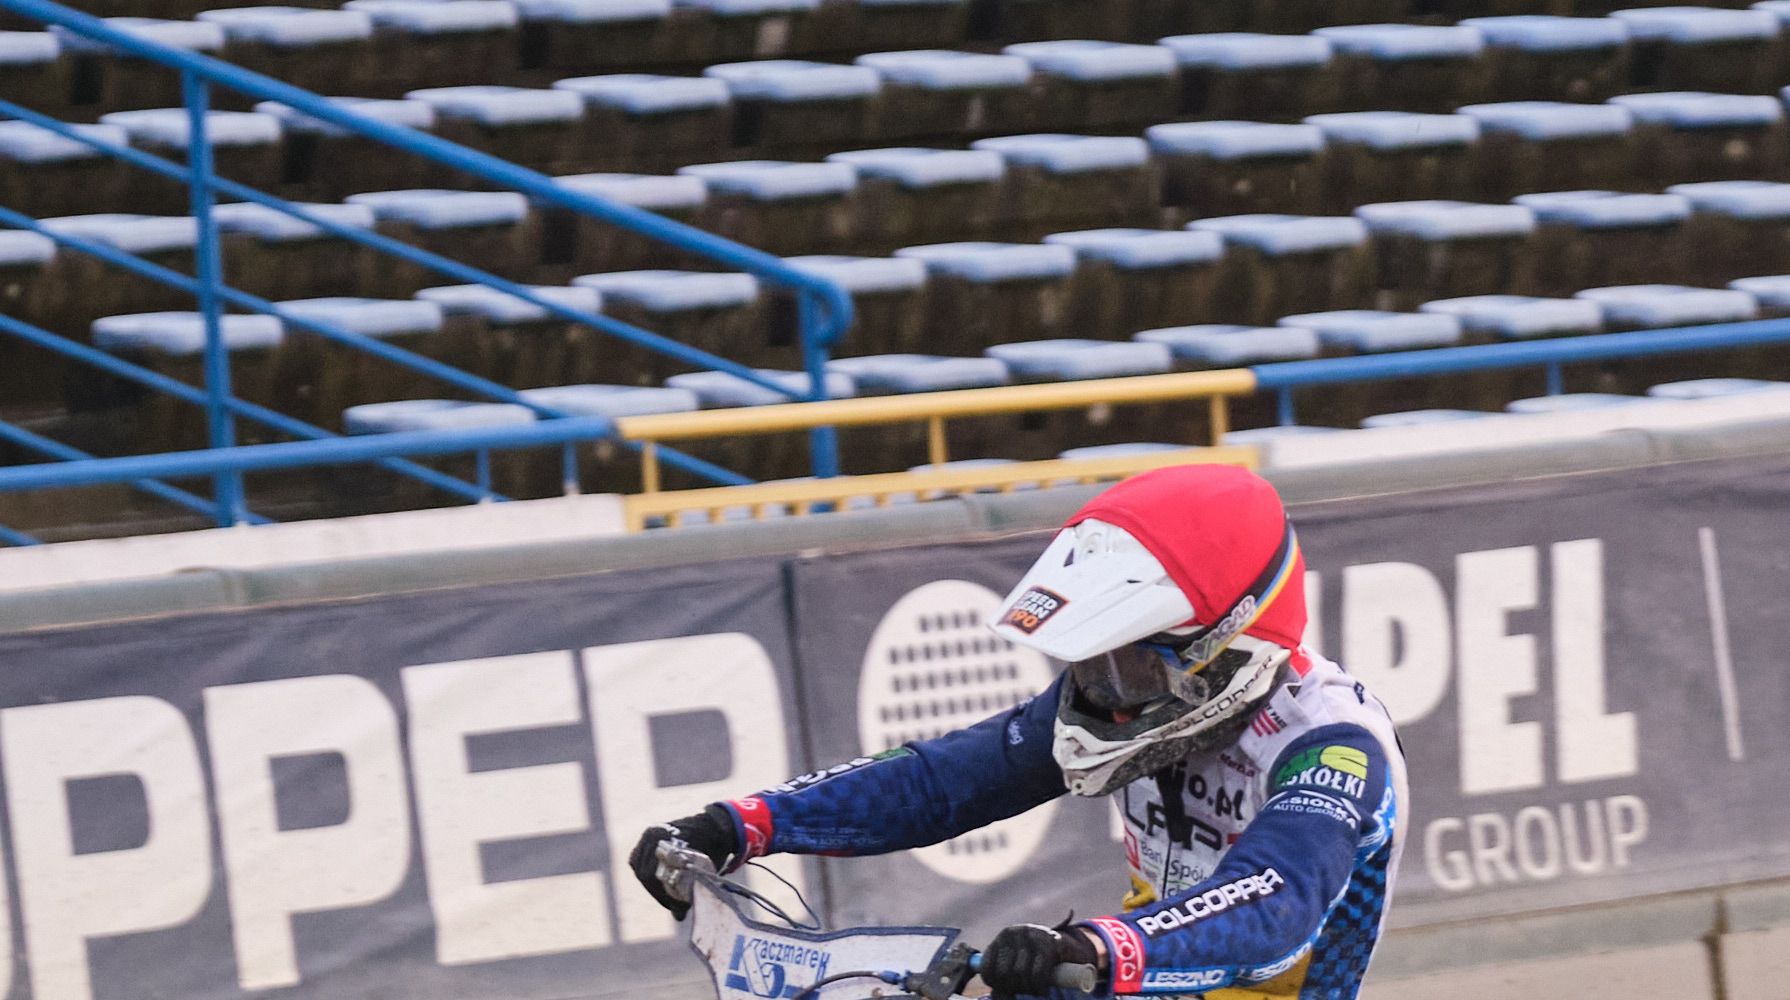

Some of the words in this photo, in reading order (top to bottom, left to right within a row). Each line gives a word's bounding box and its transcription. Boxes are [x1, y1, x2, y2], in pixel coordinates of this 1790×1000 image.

[1273, 804, 1304, 813] AUTO
[1424, 795, 1650, 893] GROUP
[1142, 968, 1226, 987] LESZNO
